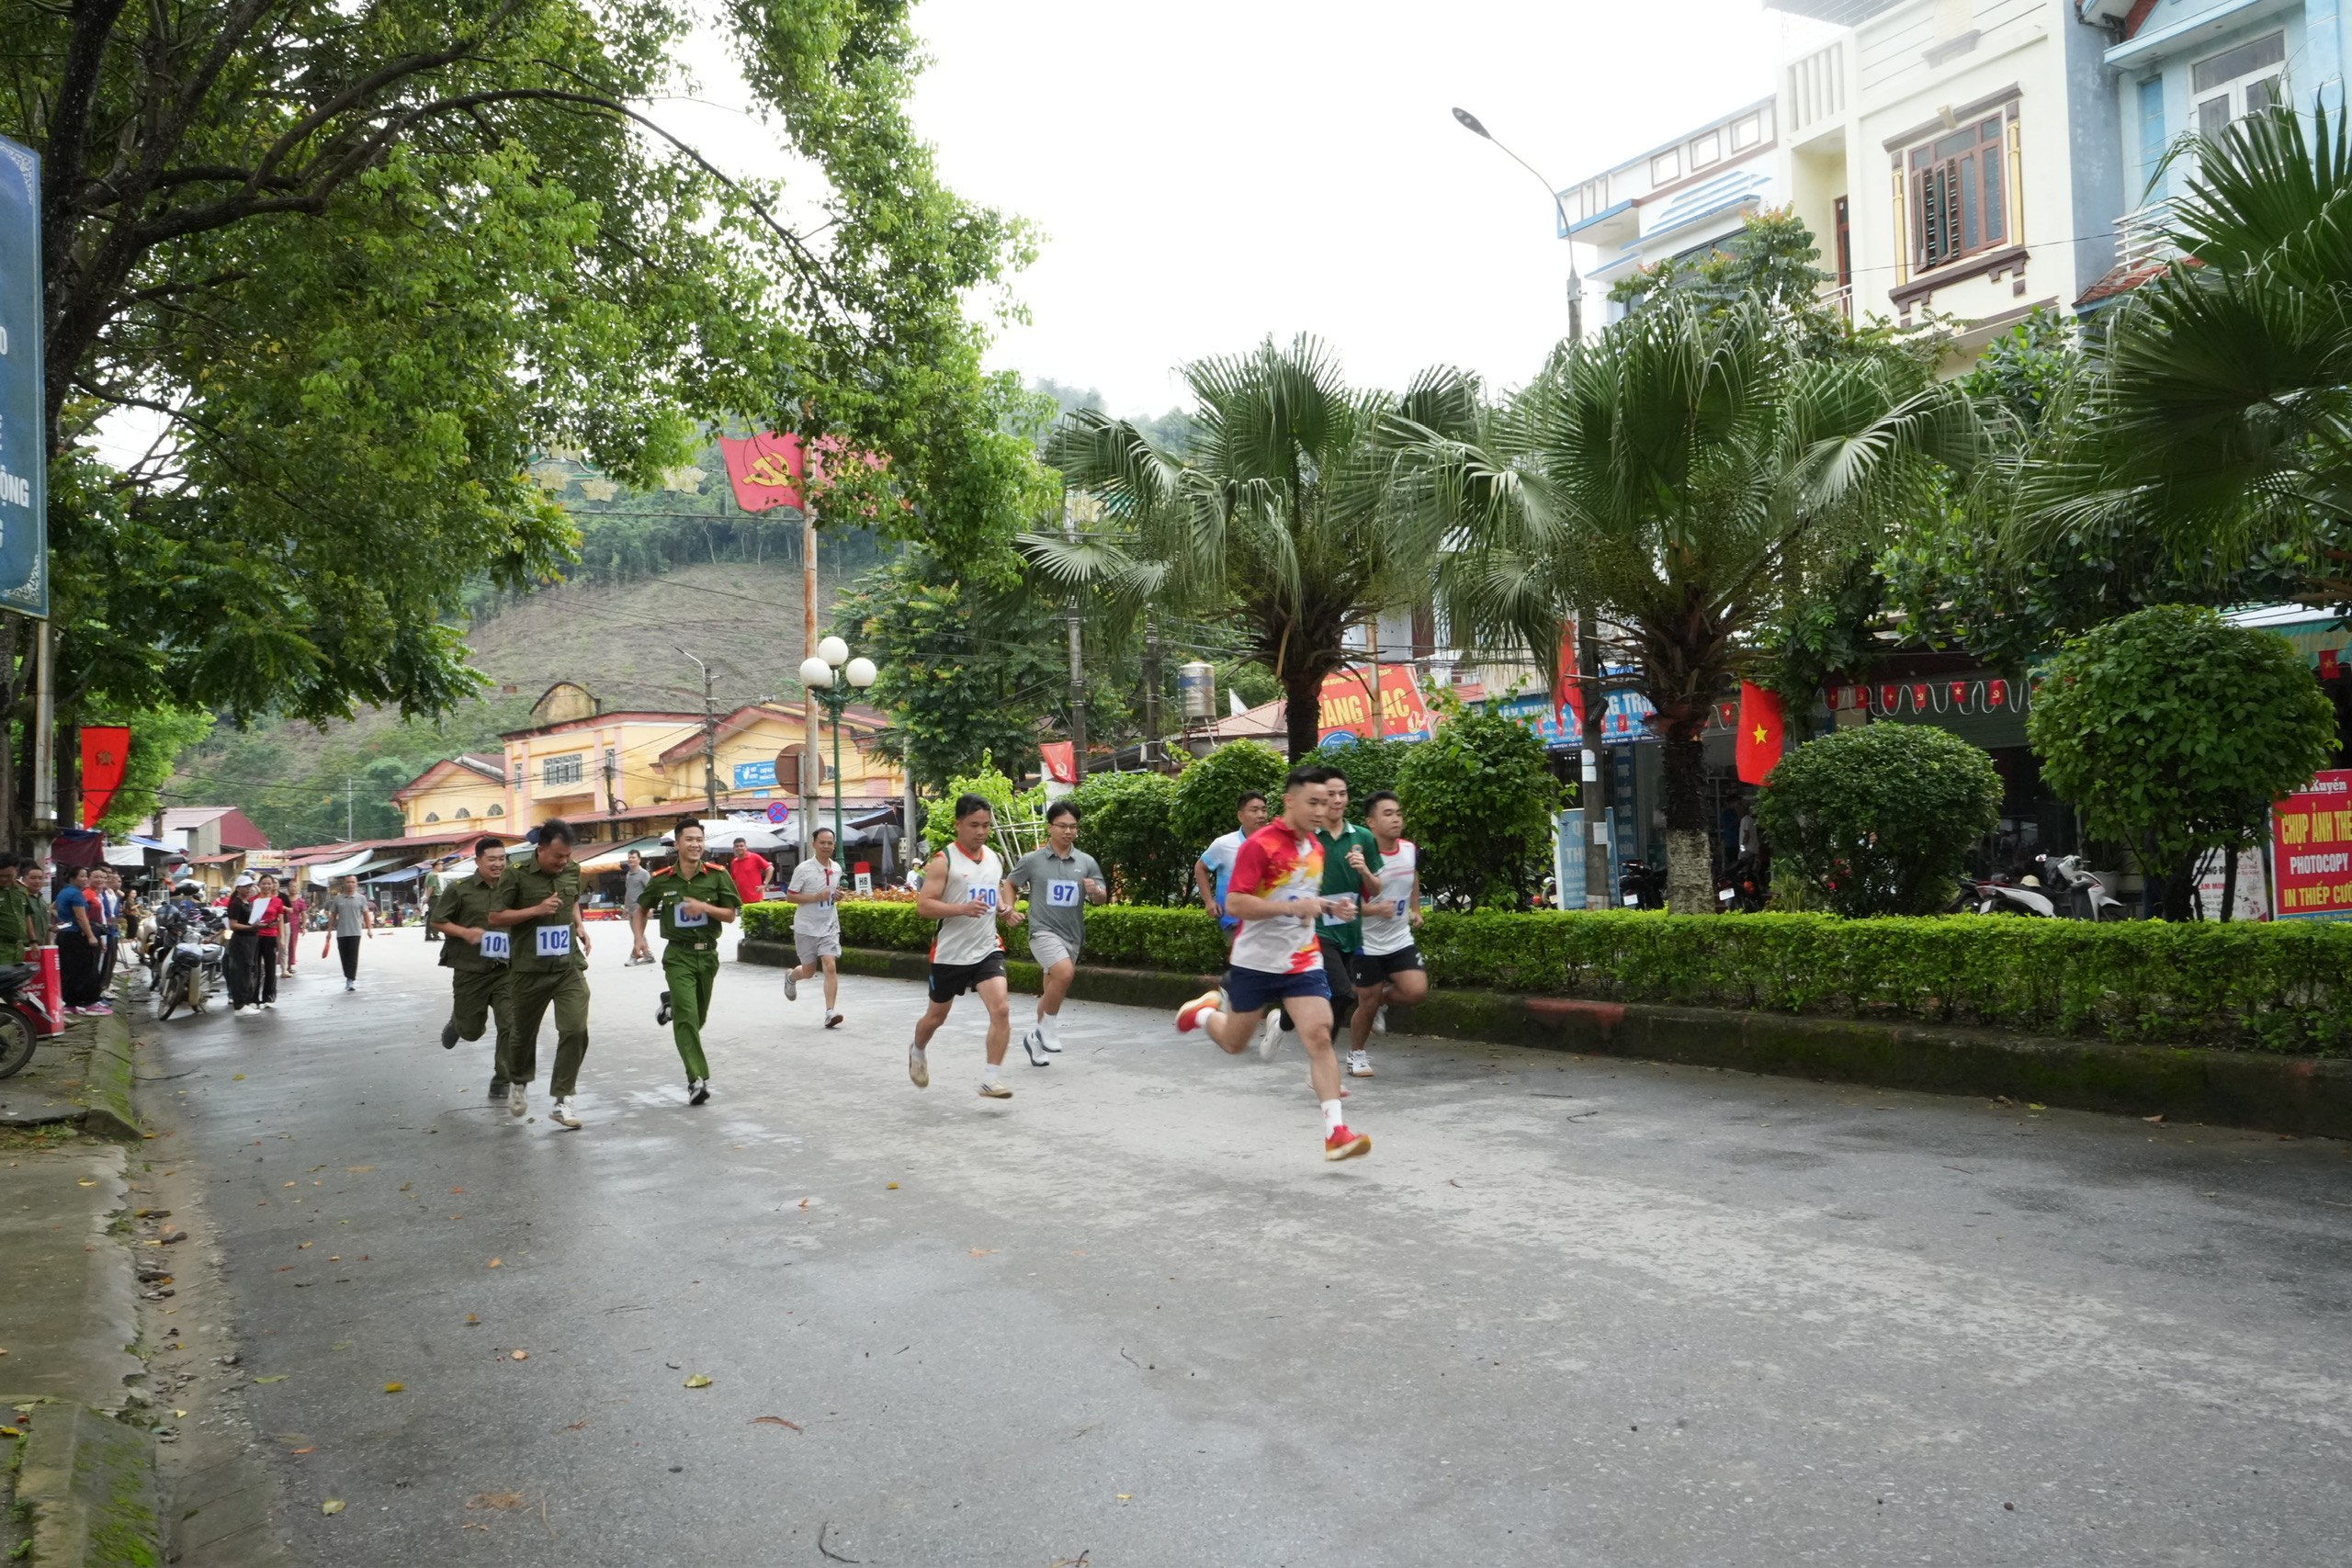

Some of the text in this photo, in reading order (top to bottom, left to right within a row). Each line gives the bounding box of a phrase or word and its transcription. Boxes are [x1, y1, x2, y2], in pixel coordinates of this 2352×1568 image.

[2281, 813, 2309, 851] CHỤP
[2312, 802, 2334, 842] ẢNH
[2290, 852, 2348, 874] PHOTOCOPY
[1053, 885, 1075, 902] 97
[2283, 888, 2297, 908] IN
[2298, 880, 2330, 907] THIẾP
[484, 935, 508, 953] 101
[540, 930, 569, 950] 102
